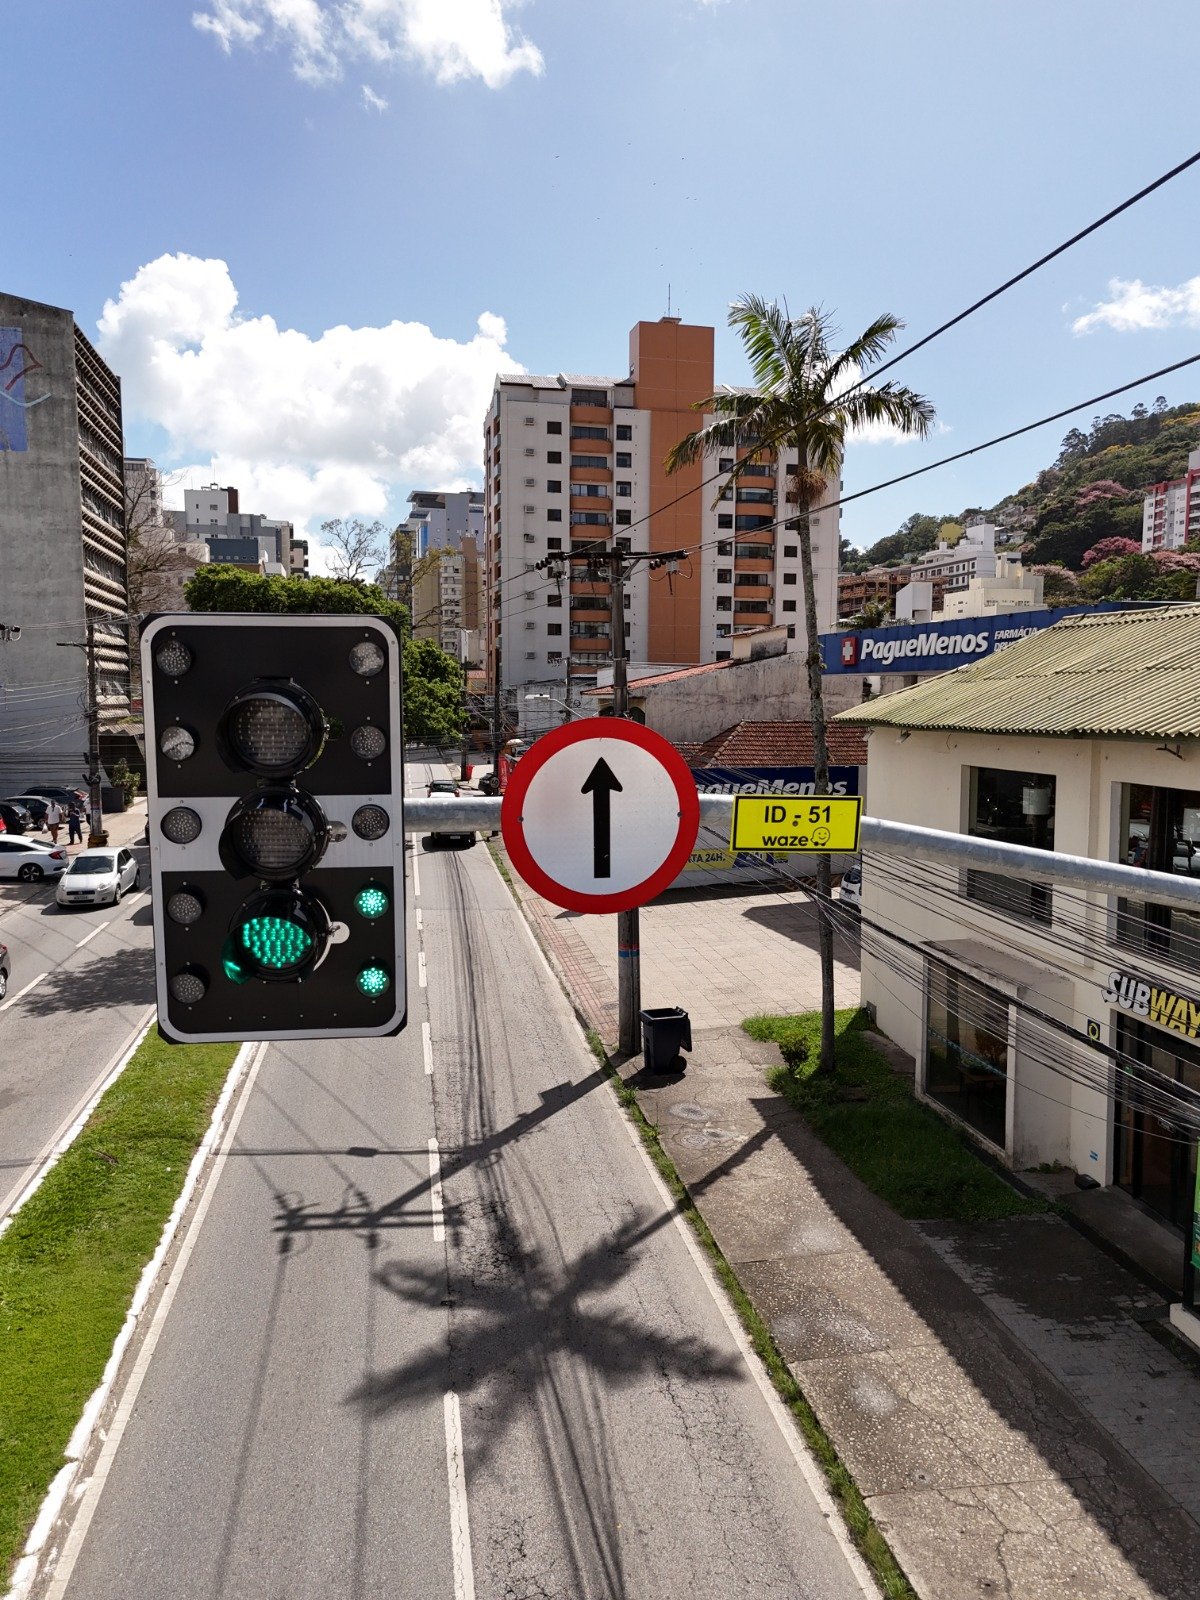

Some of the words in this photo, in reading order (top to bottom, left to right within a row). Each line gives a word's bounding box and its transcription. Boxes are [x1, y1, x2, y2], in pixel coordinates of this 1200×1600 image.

[994, 625, 1038, 640] FARMÁCIA
[860, 631, 989, 665] PagueMenos
[764, 805, 787, 824] ID
[808, 805, 831, 824] 51
[762, 835, 809, 847] waze
[1101, 971, 1200, 1039] SUBWAY
